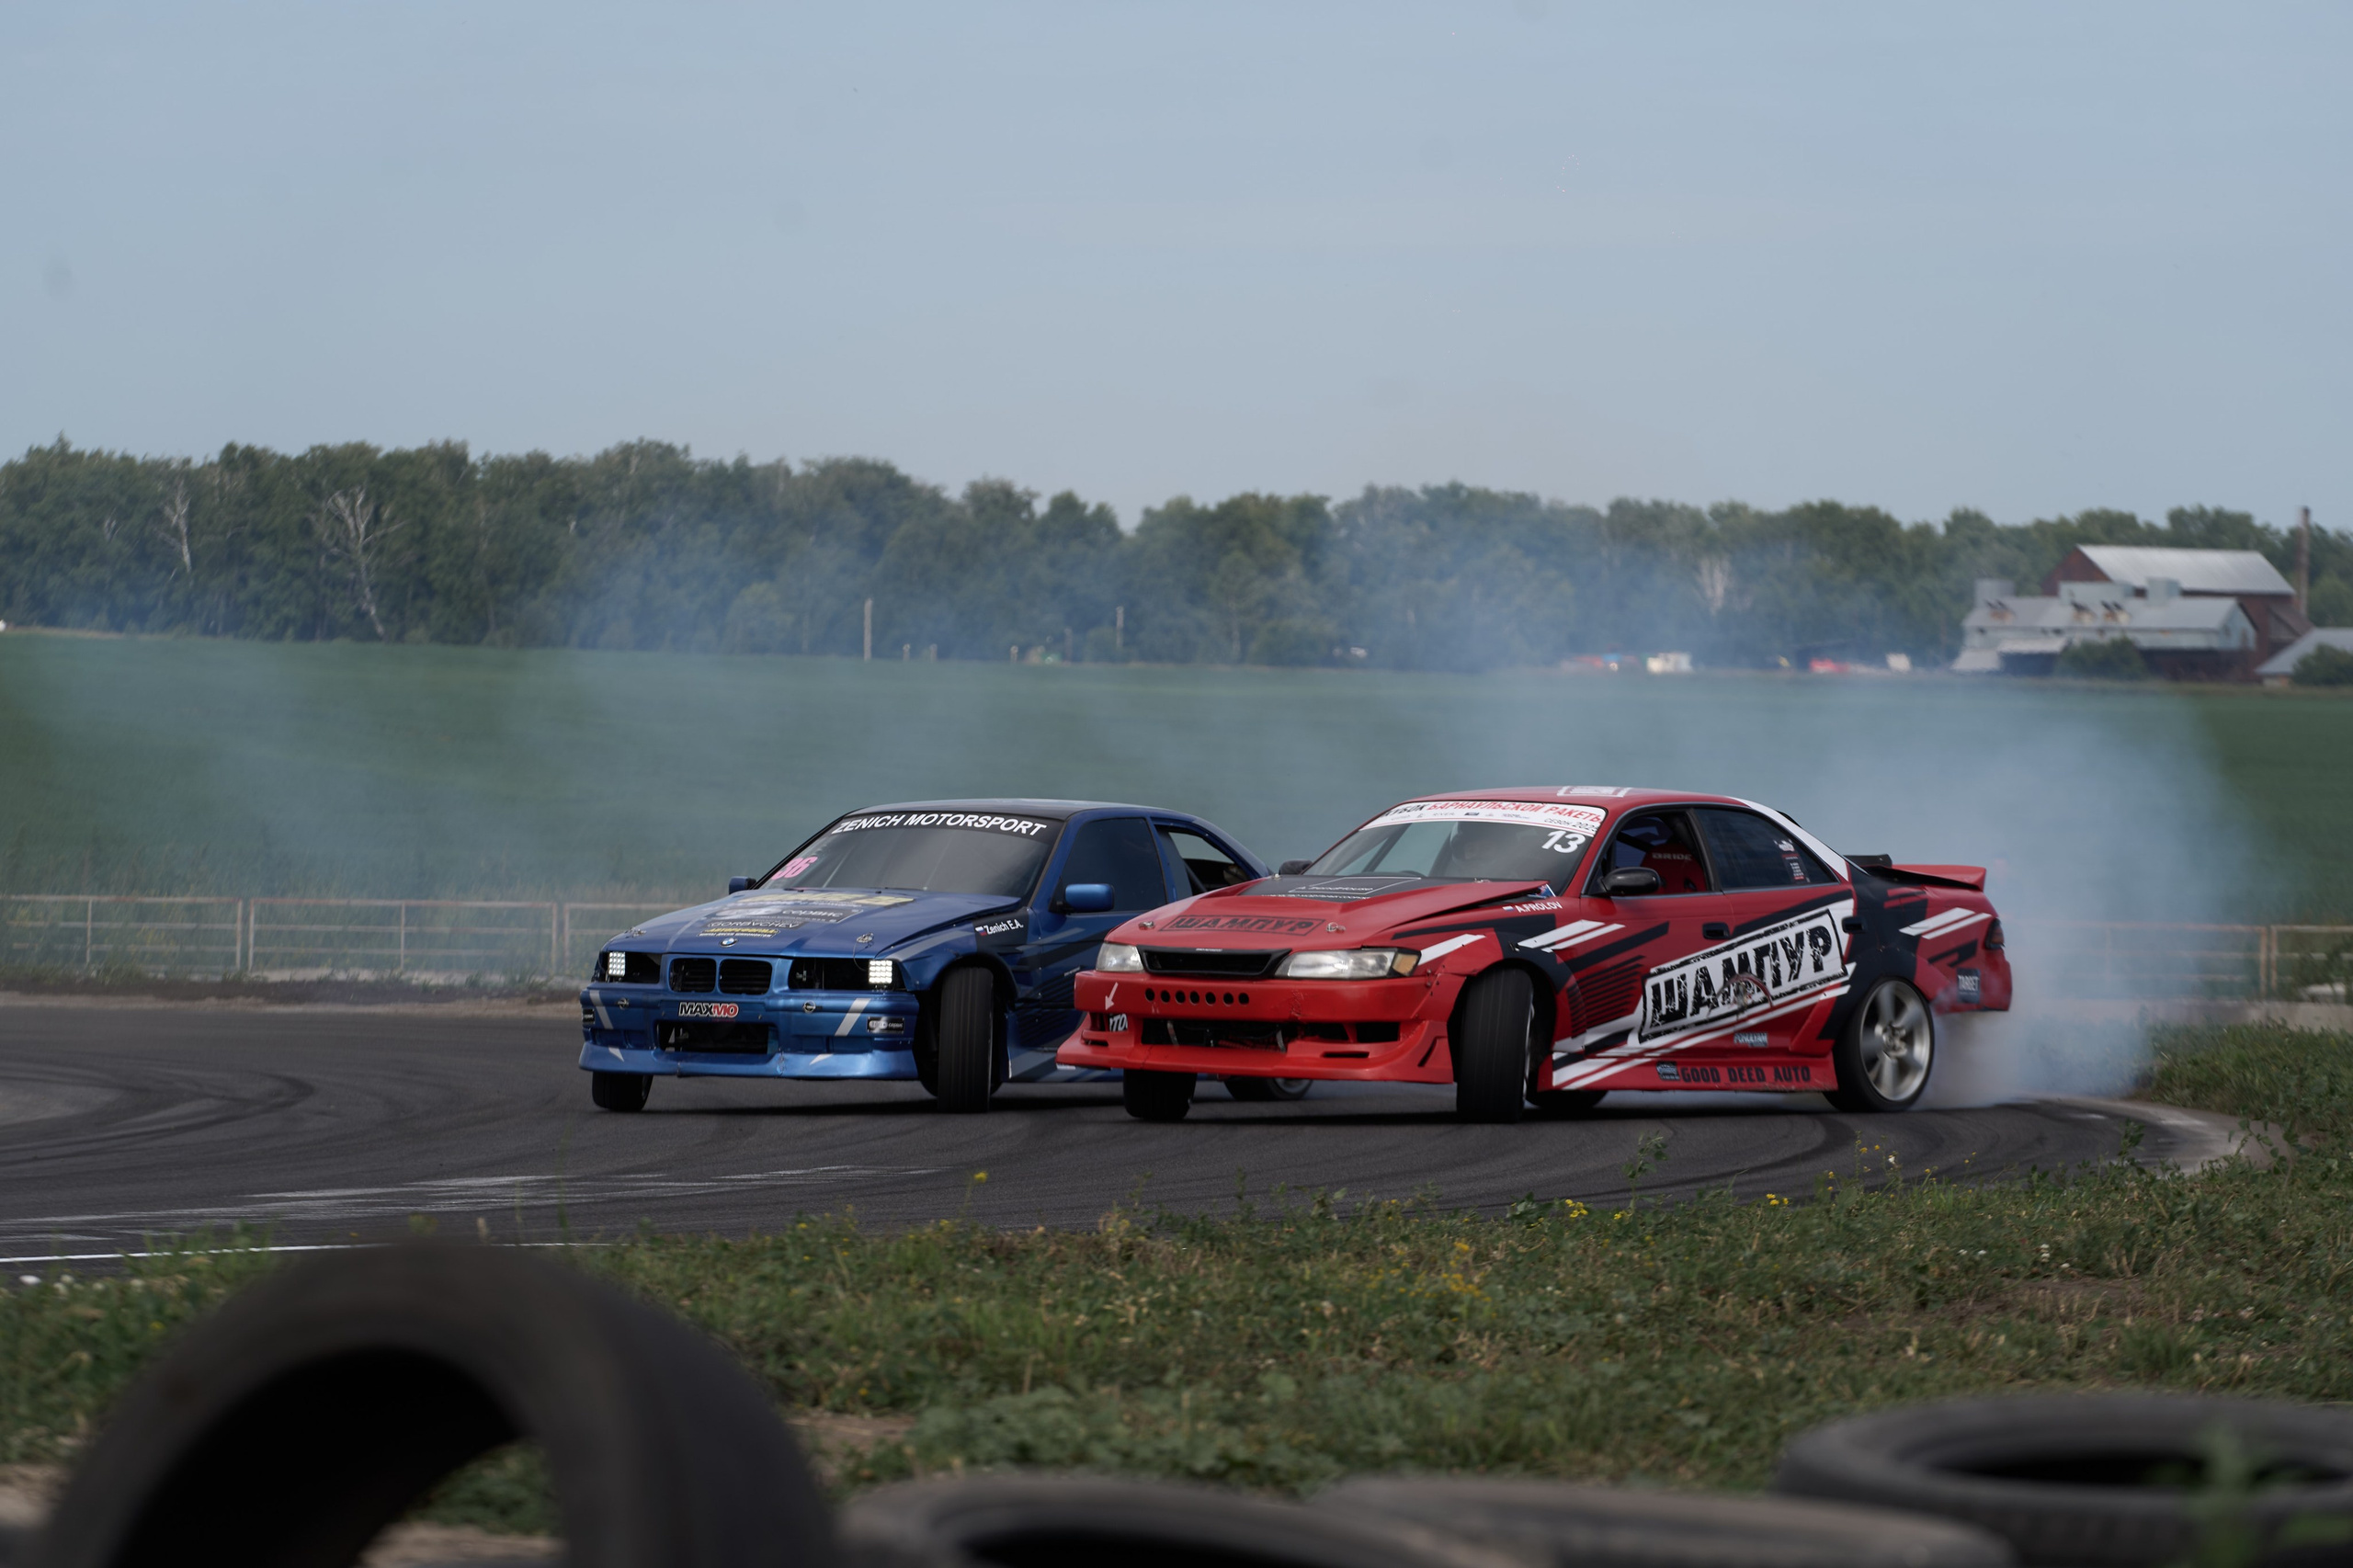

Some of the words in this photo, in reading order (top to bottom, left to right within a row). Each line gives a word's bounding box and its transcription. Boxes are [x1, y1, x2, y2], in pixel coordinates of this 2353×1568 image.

[1427, 801, 1545, 813] БАРНАУЛЬСКОЙ
[831, 814, 906, 835] ZENICH
[904, 812, 1047, 836] MOTORSPORT
[1541, 830, 1586, 853] 13
[1652, 852, 1692, 861] BRIDE
[1515, 901, 1563, 913] A.FROLOV
[983, 922, 1009, 935] Zenich
[1007, 919, 1024, 929] E.A.
[1169, 917, 1315, 932] ШАМПУР
[1650, 926, 1833, 1029] ШАМПУР
[678, 1001, 739, 1017] MAXMO
[1680, 1066, 1722, 1084] GOOD
[1727, 1066, 1767, 1083] DEED
[1773, 1065, 1812, 1083] AUTO
